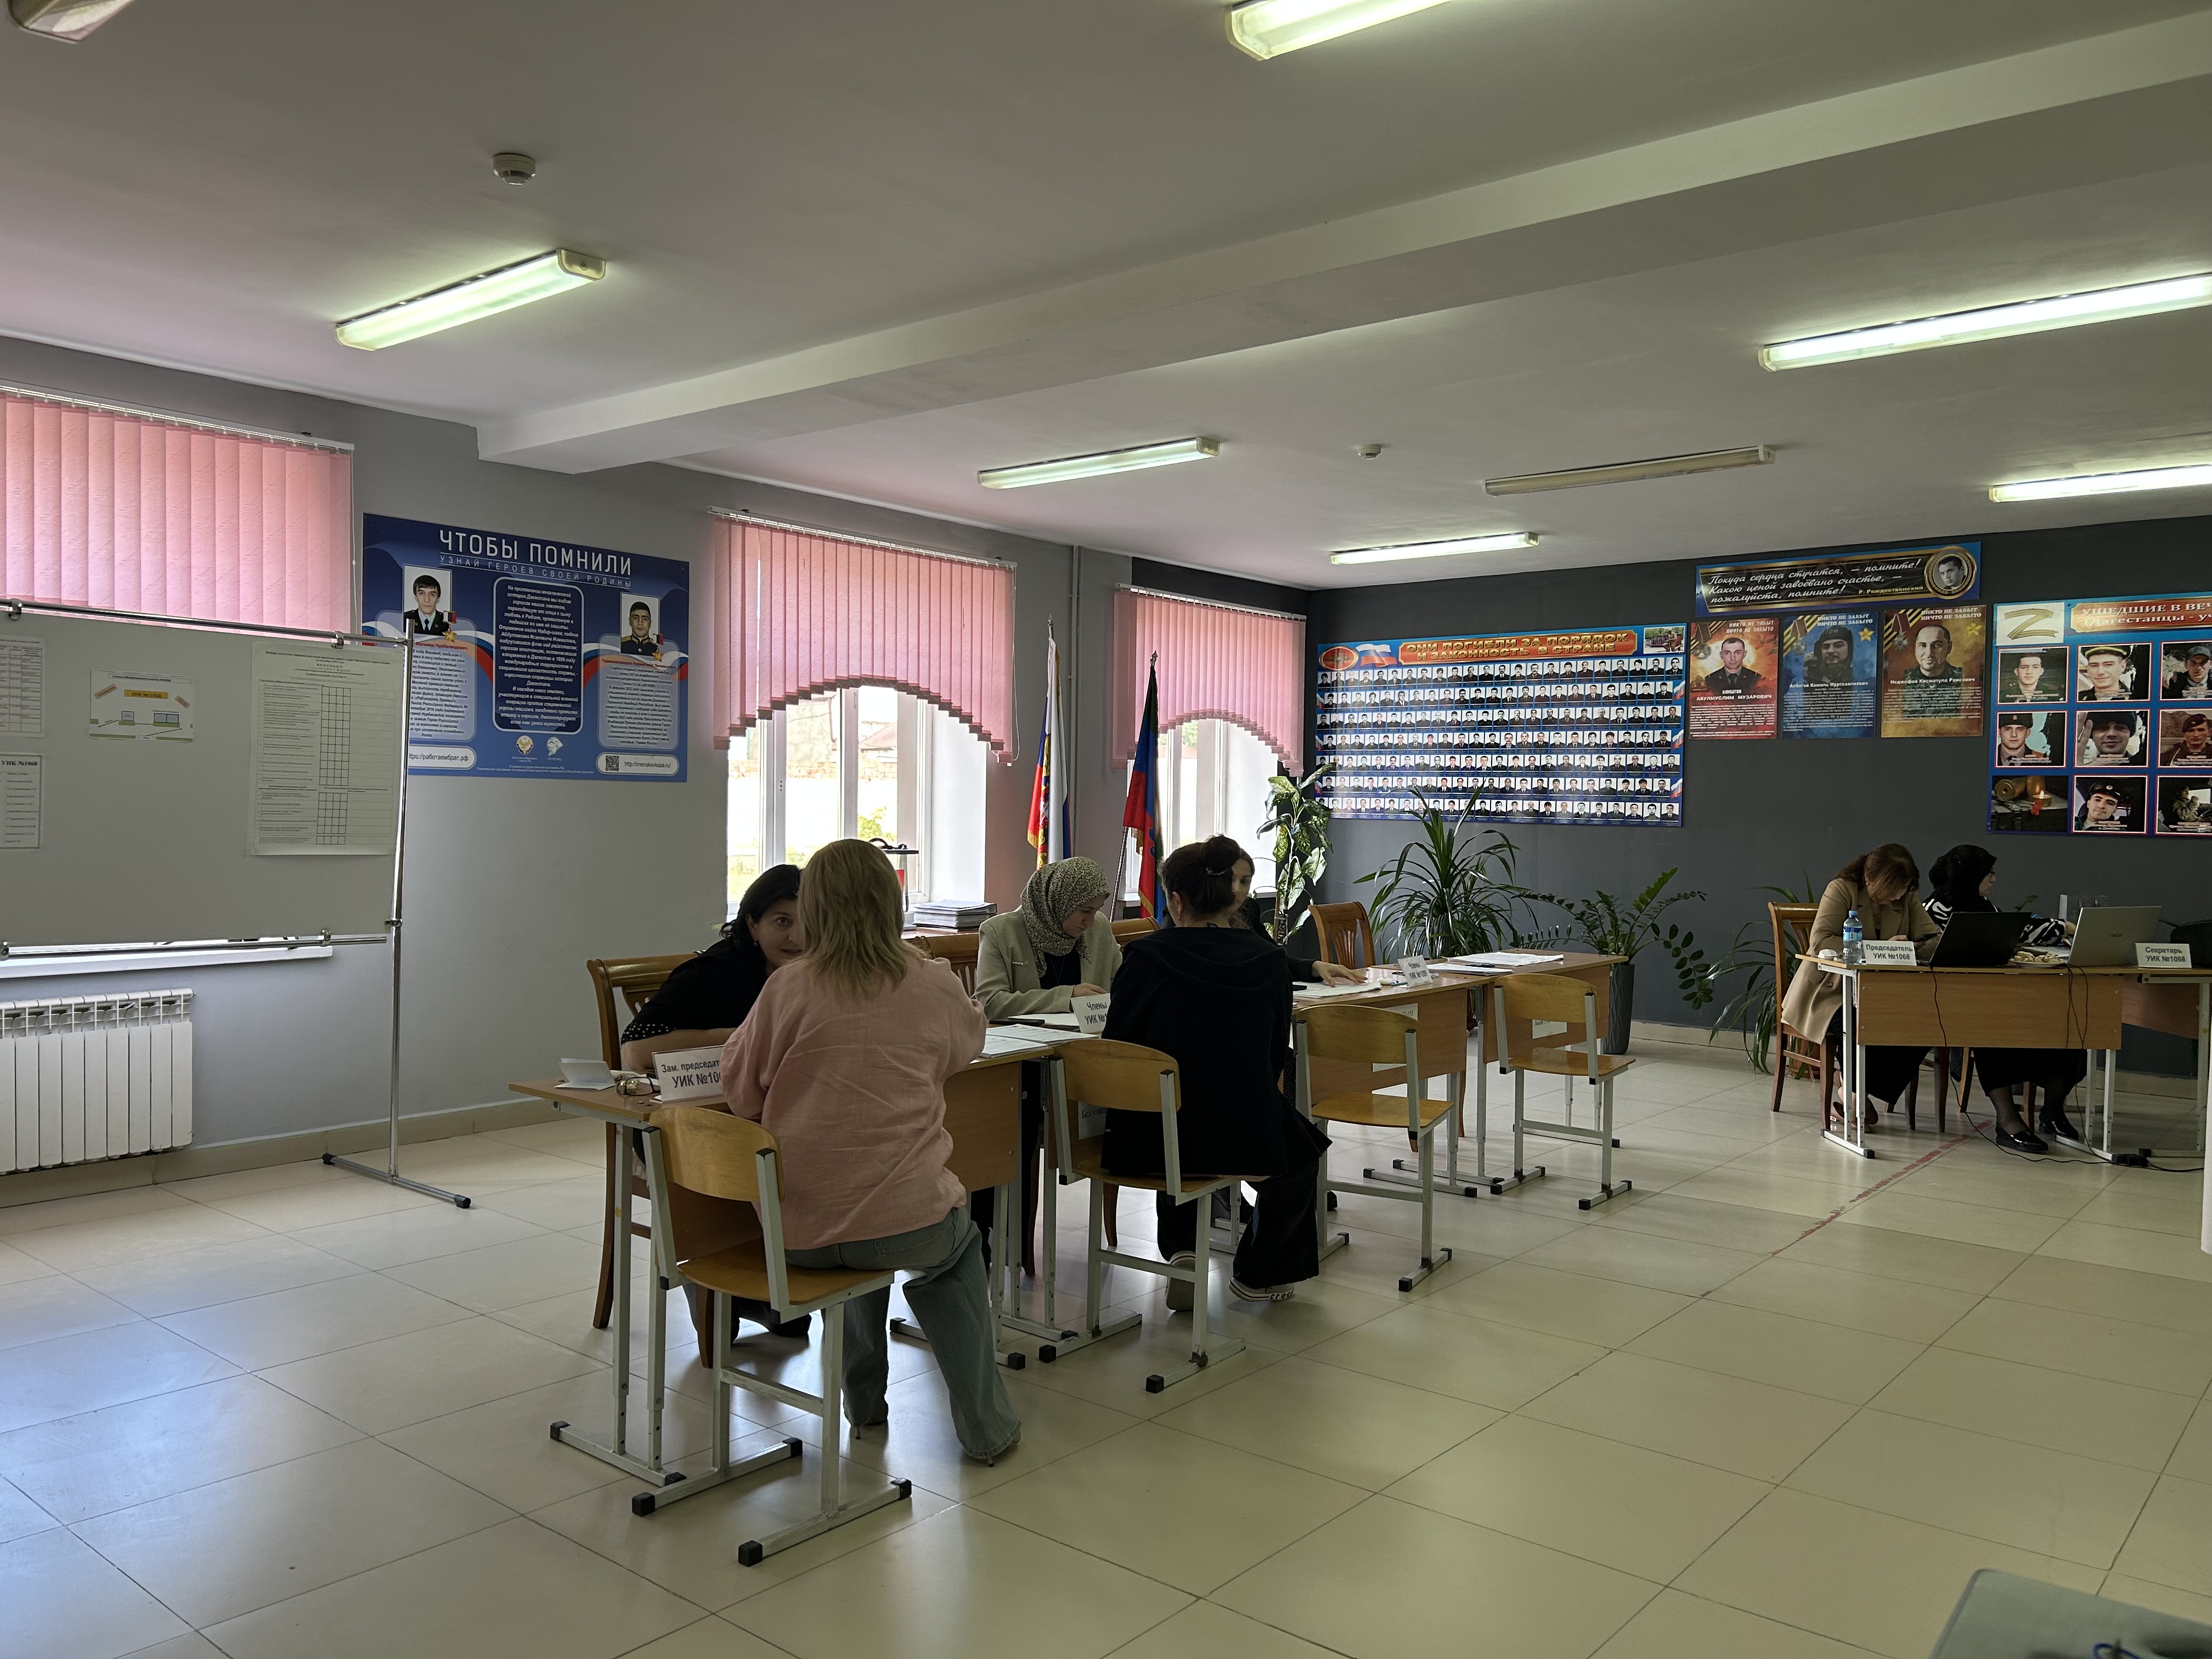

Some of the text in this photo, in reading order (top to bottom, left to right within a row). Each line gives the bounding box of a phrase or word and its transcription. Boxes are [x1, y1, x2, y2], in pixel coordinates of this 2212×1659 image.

[440, 529, 631, 575] ЧТОБЫ ПОМНИЛИ
[440, 555, 631, 588] УЗНАЙ ГЕРОЕВ СВОЕЙ РОДИНЫ
[1708, 575, 1746, 585] Покуда
[1750, 572, 1784, 583] сердца
[1788, 568, 1843, 579] стучатся,
[1864, 558, 1921, 572] помните!
[1708, 585, 1742, 595] Какою
[1747, 582, 1777, 592] ценой
[1780, 578, 1833, 589] завоёвано
[1838, 575, 1884, 585] счастье,
[1866, 586, 1923, 594] Рождественский
[1711, 585, 1846, 603] пожалуйста, помните!
[2082, 605, 2166, 617] УШЕДШИЕ
[2085, 615, 2185, 628] (Дагестанцы
[1407, 633, 1628, 653] ОНИ ПОГИБЛИ ЗА ПОРЯДОК
[1417, 652, 1427, 660] И
[1430, 647, 1530, 659] ЗАКОННОСТЬ
[1552, 644, 1616, 653] СТРАНЕ
[1866, 944, 1914, 952] Председатель
[2145, 946, 2183, 955] Секретарь
[1086, 1001, 1108, 1011] Члены
[1085, 1014, 1098, 1024] УИК
[661, 1060, 720, 1073] Зам. председат
[672, 1071, 721, 1088] УИК №10
